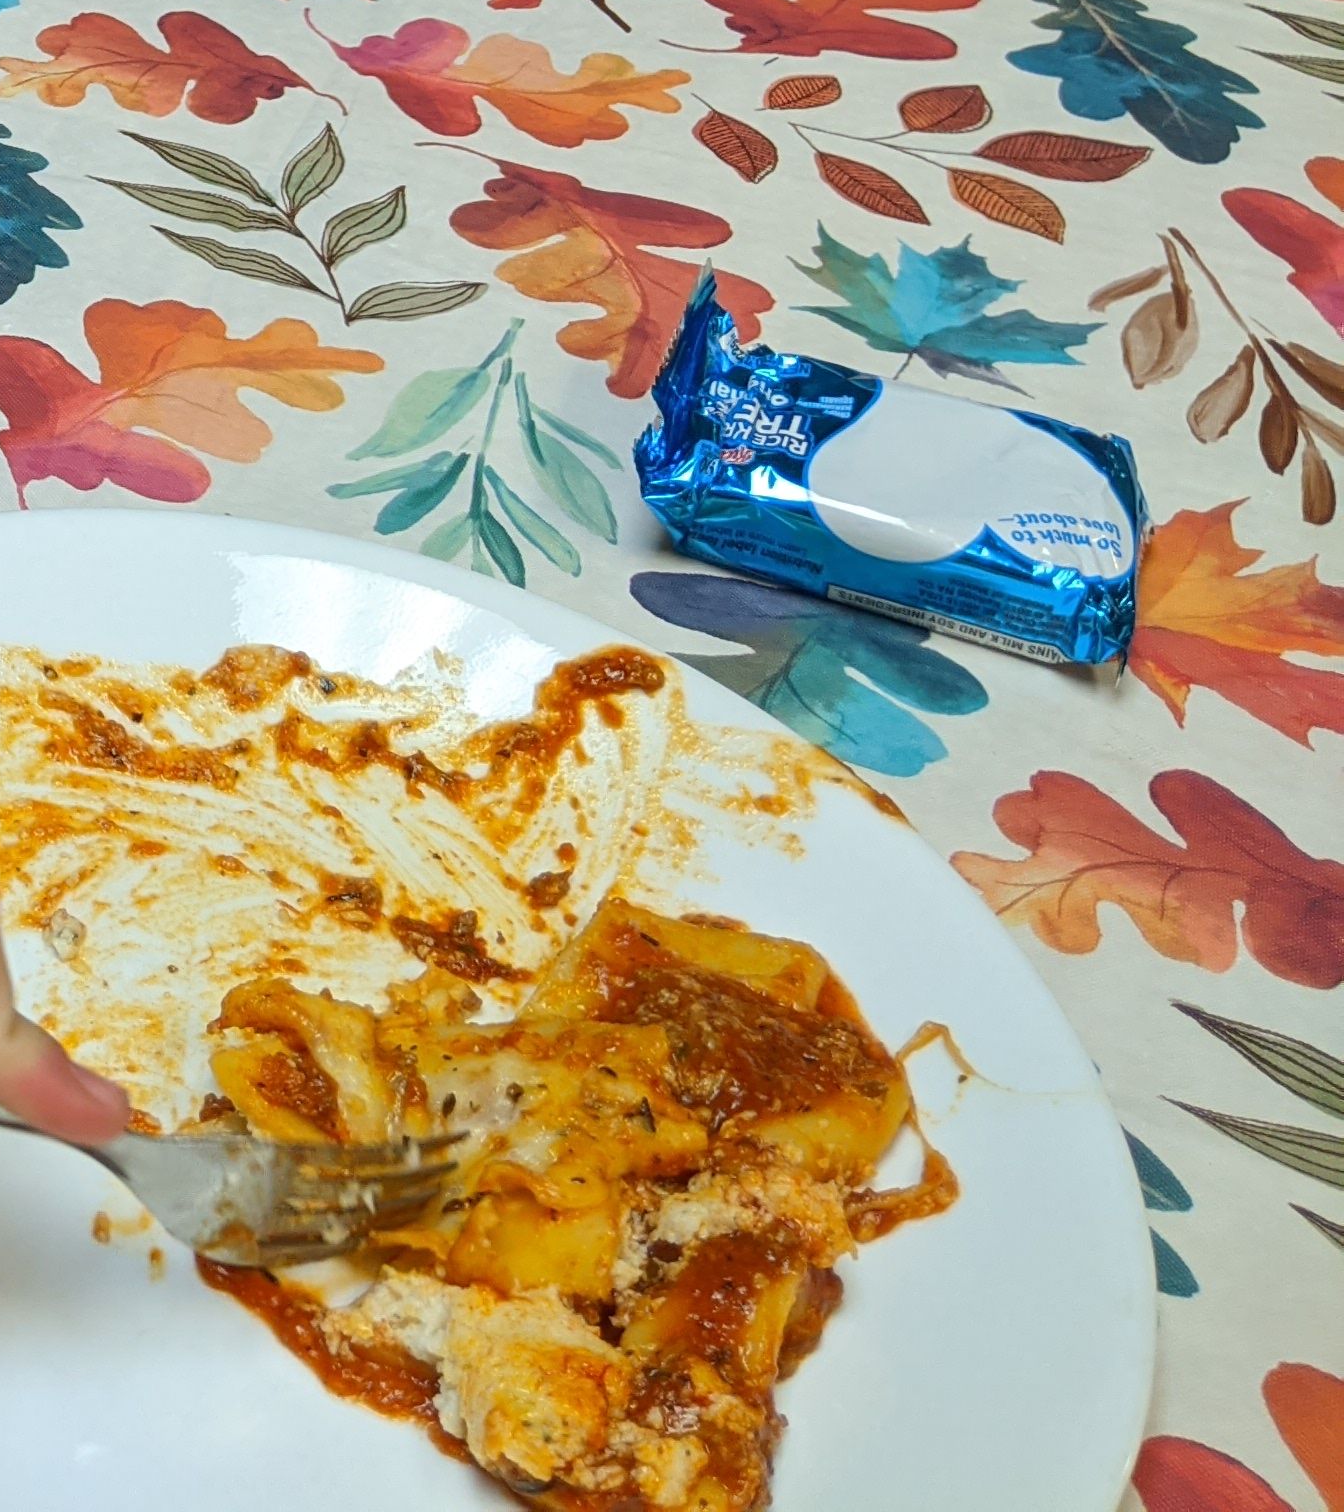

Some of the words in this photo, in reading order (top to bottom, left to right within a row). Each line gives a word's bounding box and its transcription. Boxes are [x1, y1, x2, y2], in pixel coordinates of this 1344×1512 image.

[751, 433, 809, 457] RICE
[1010, 529, 1037, 546] to
[1080, 515, 1122, 542] love
[1039, 529, 1094, 552] much
[1096, 536, 1123, 559] So
[927, 615, 955, 632] SOY
[957, 624, 988, 641] AND
[989, 634, 1023, 651] MILK
